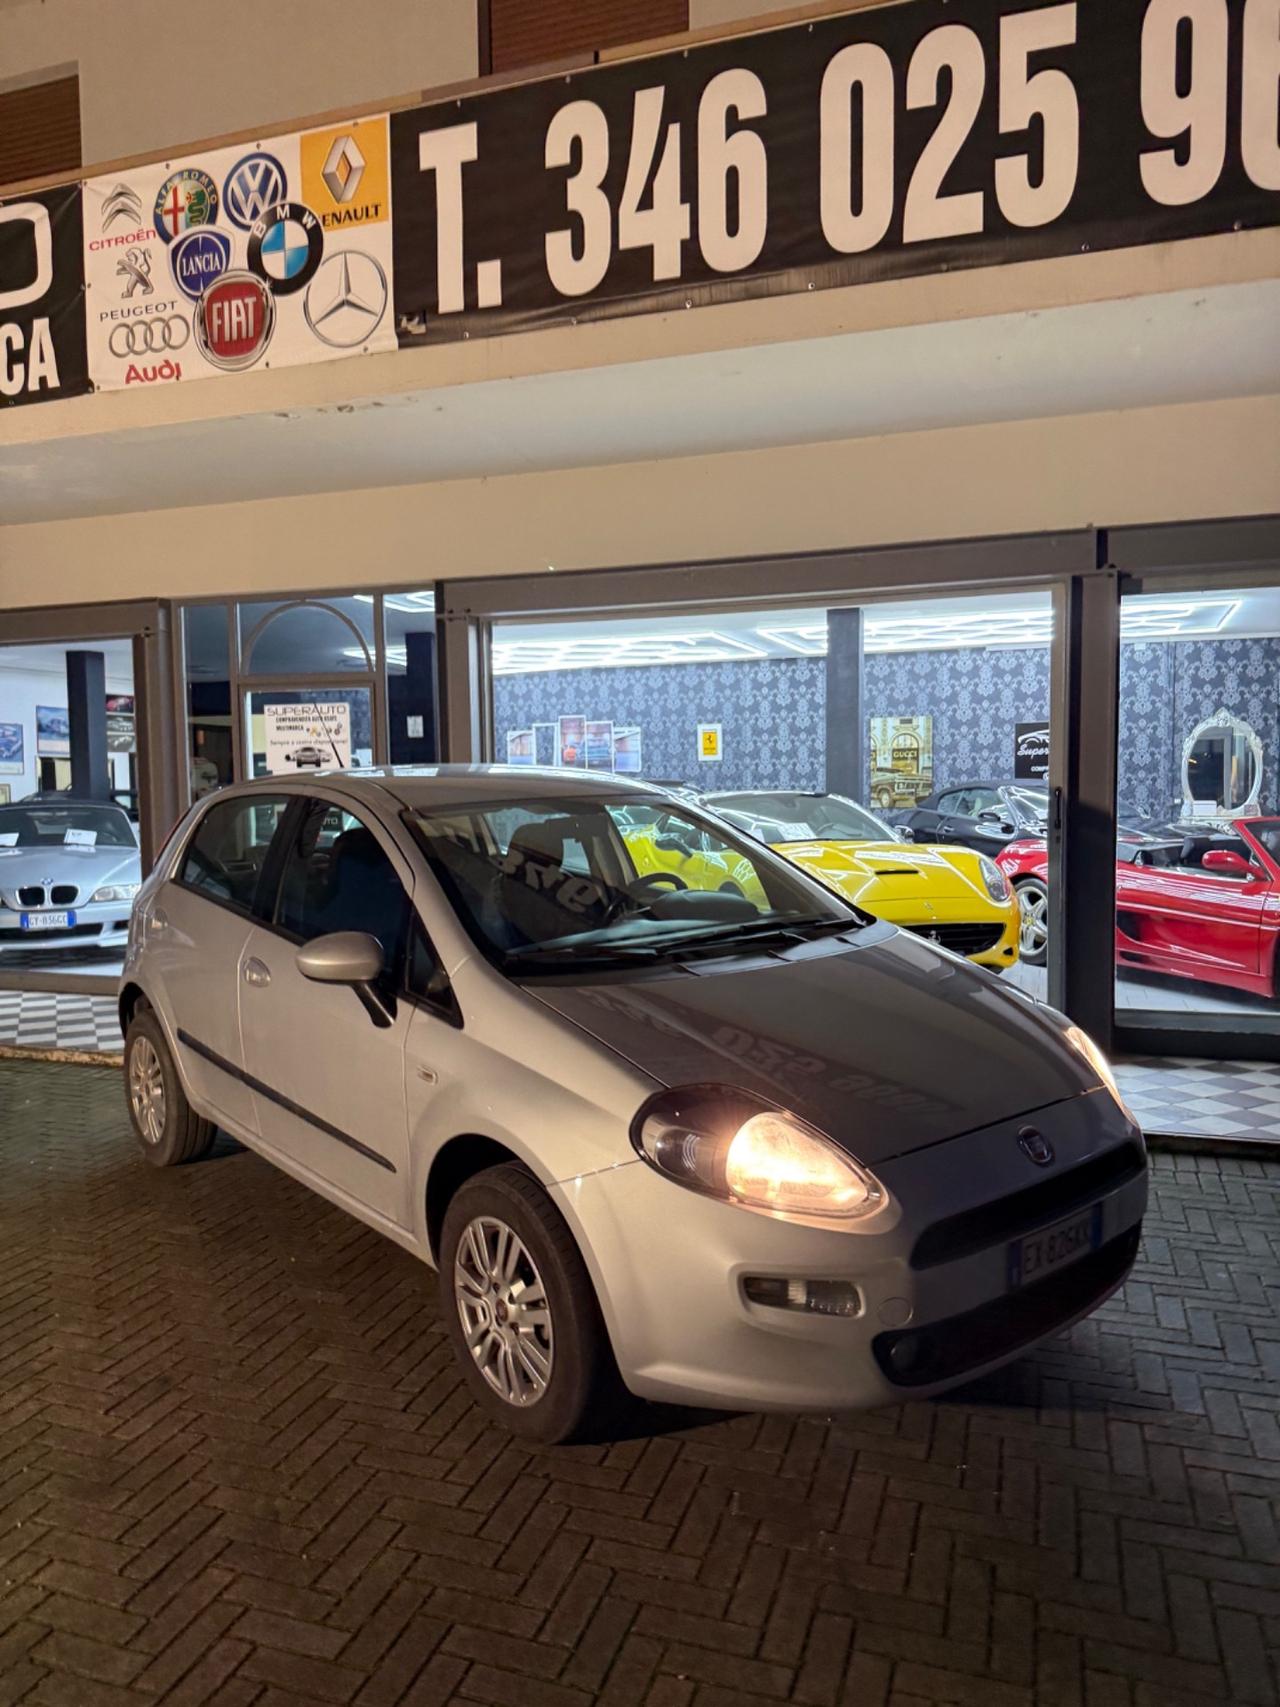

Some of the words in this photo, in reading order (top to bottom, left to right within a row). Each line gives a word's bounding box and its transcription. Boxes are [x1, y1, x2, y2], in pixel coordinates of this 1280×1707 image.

[419, 121, 502, 314] T.
[545, 68, 768, 297] 346
[820, 2, 1080, 253] 025
[253, 204, 317, 238] BMW
[322, 204, 382, 227] ENAULT
[181, 254, 222, 277] LANCIA
[100, 301, 179, 322] PEUGEOT
[212, 297, 257, 344] FIAT
[125, 360, 182, 384] Audi
